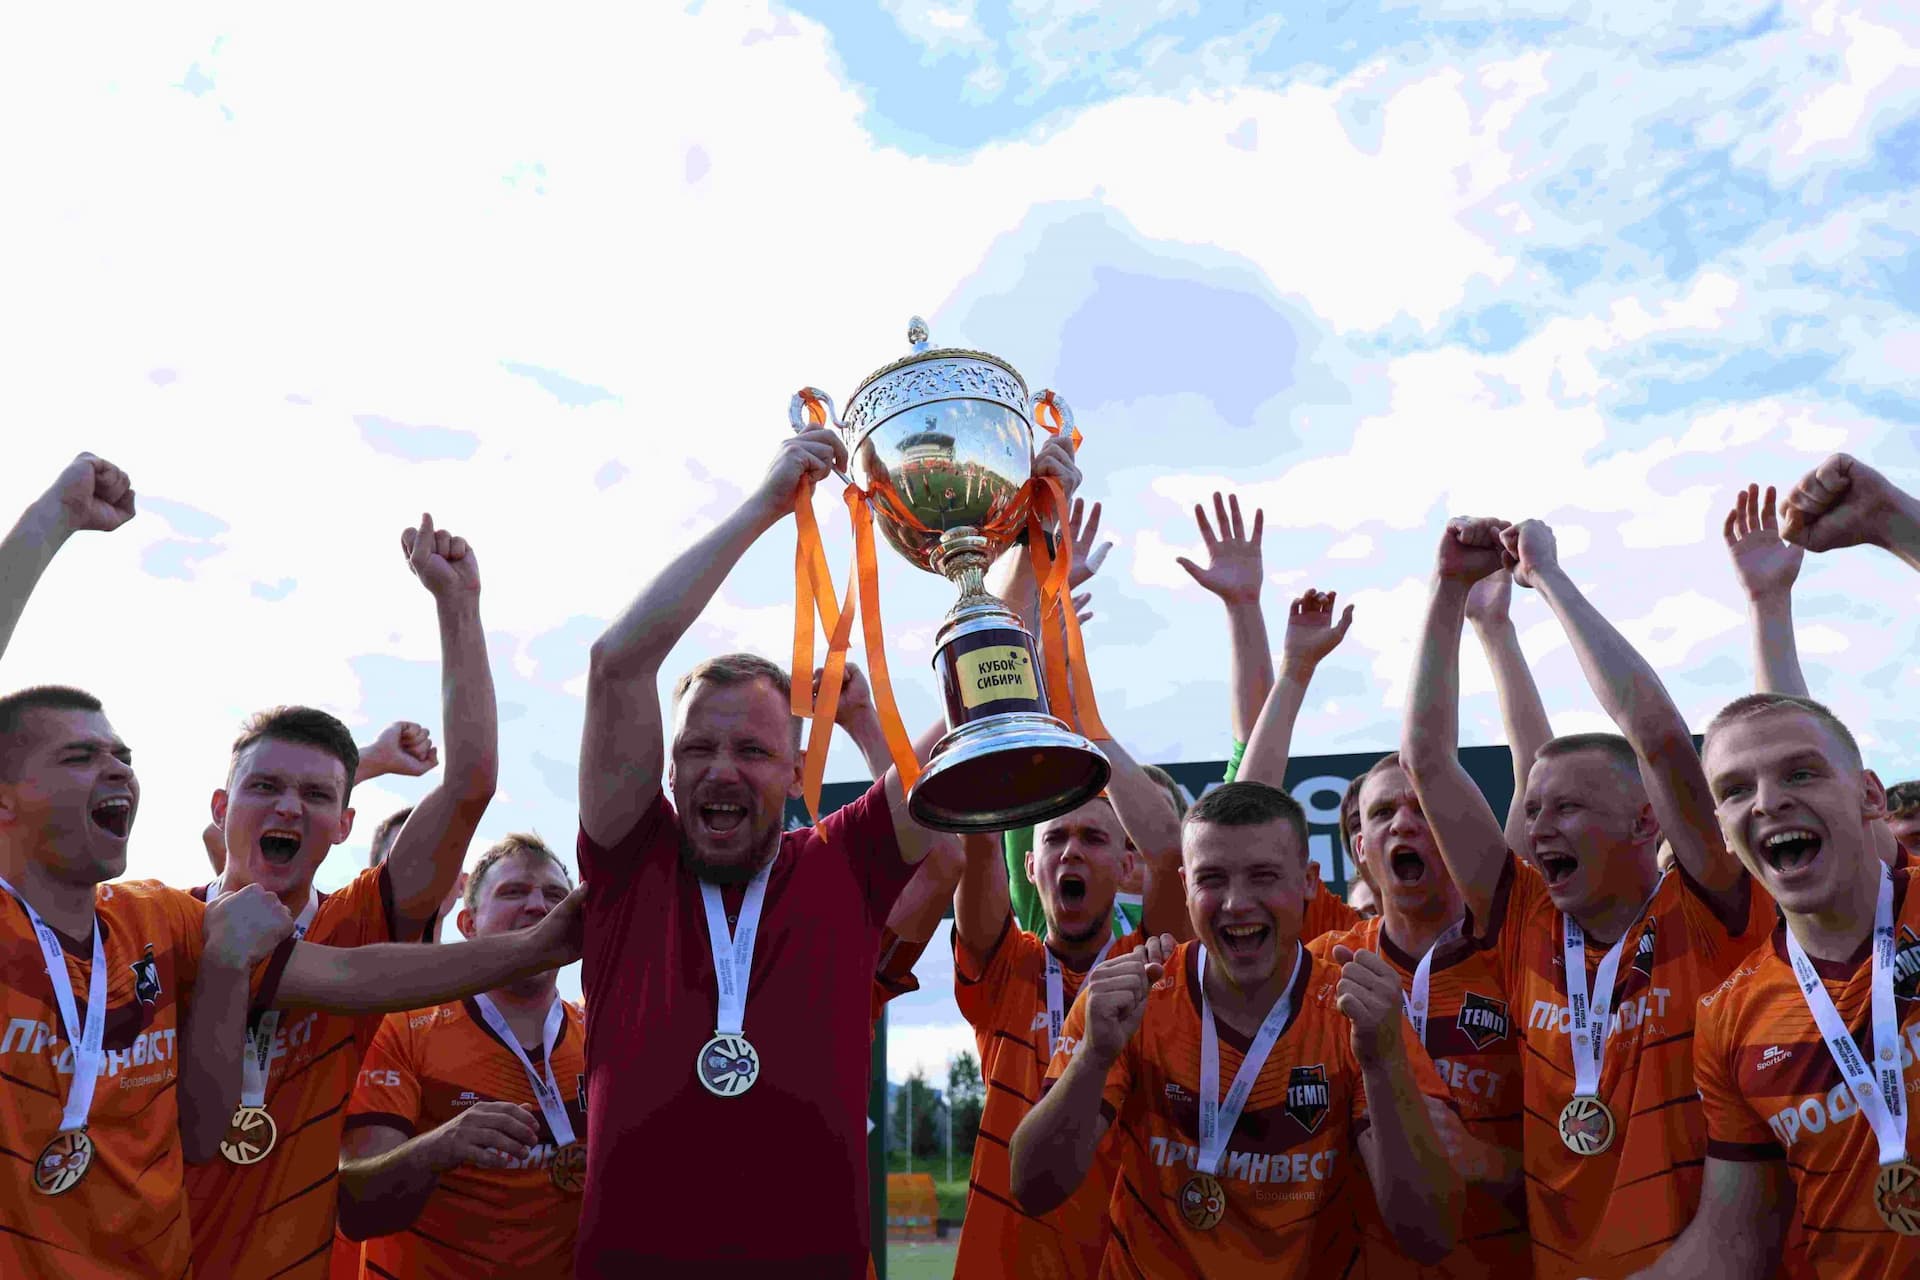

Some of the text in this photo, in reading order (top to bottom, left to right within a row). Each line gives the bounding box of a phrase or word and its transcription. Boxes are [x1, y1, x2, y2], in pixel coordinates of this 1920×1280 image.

[978, 660, 1016, 675] КУБОК
[977, 674, 1023, 690] СИБИРИ
[1463, 1008, 1505, 1034] ТЕМП
[1756, 1050, 1793, 1071] SportLife
[1287, 1083, 1328, 1109] ТЕМП
[1151, 1136, 1341, 1184] ПРОИНВЕСТ
